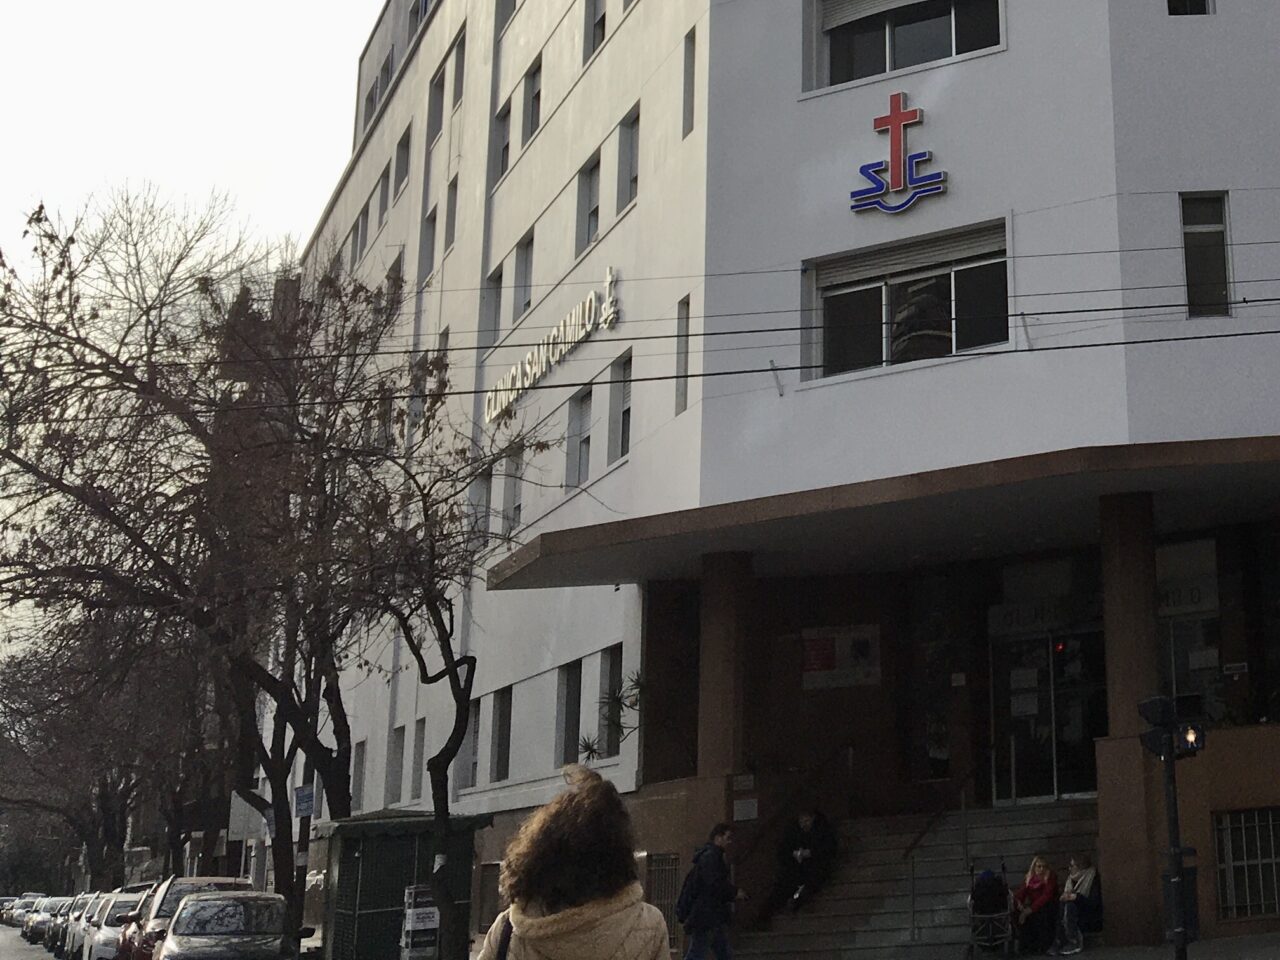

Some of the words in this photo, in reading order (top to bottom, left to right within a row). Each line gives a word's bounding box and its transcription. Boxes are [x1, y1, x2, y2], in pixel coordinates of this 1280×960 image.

[485, 360, 522, 424] CLINICA
[524, 335, 548, 388] SAN
[549, 290, 596, 365] CAMILO
